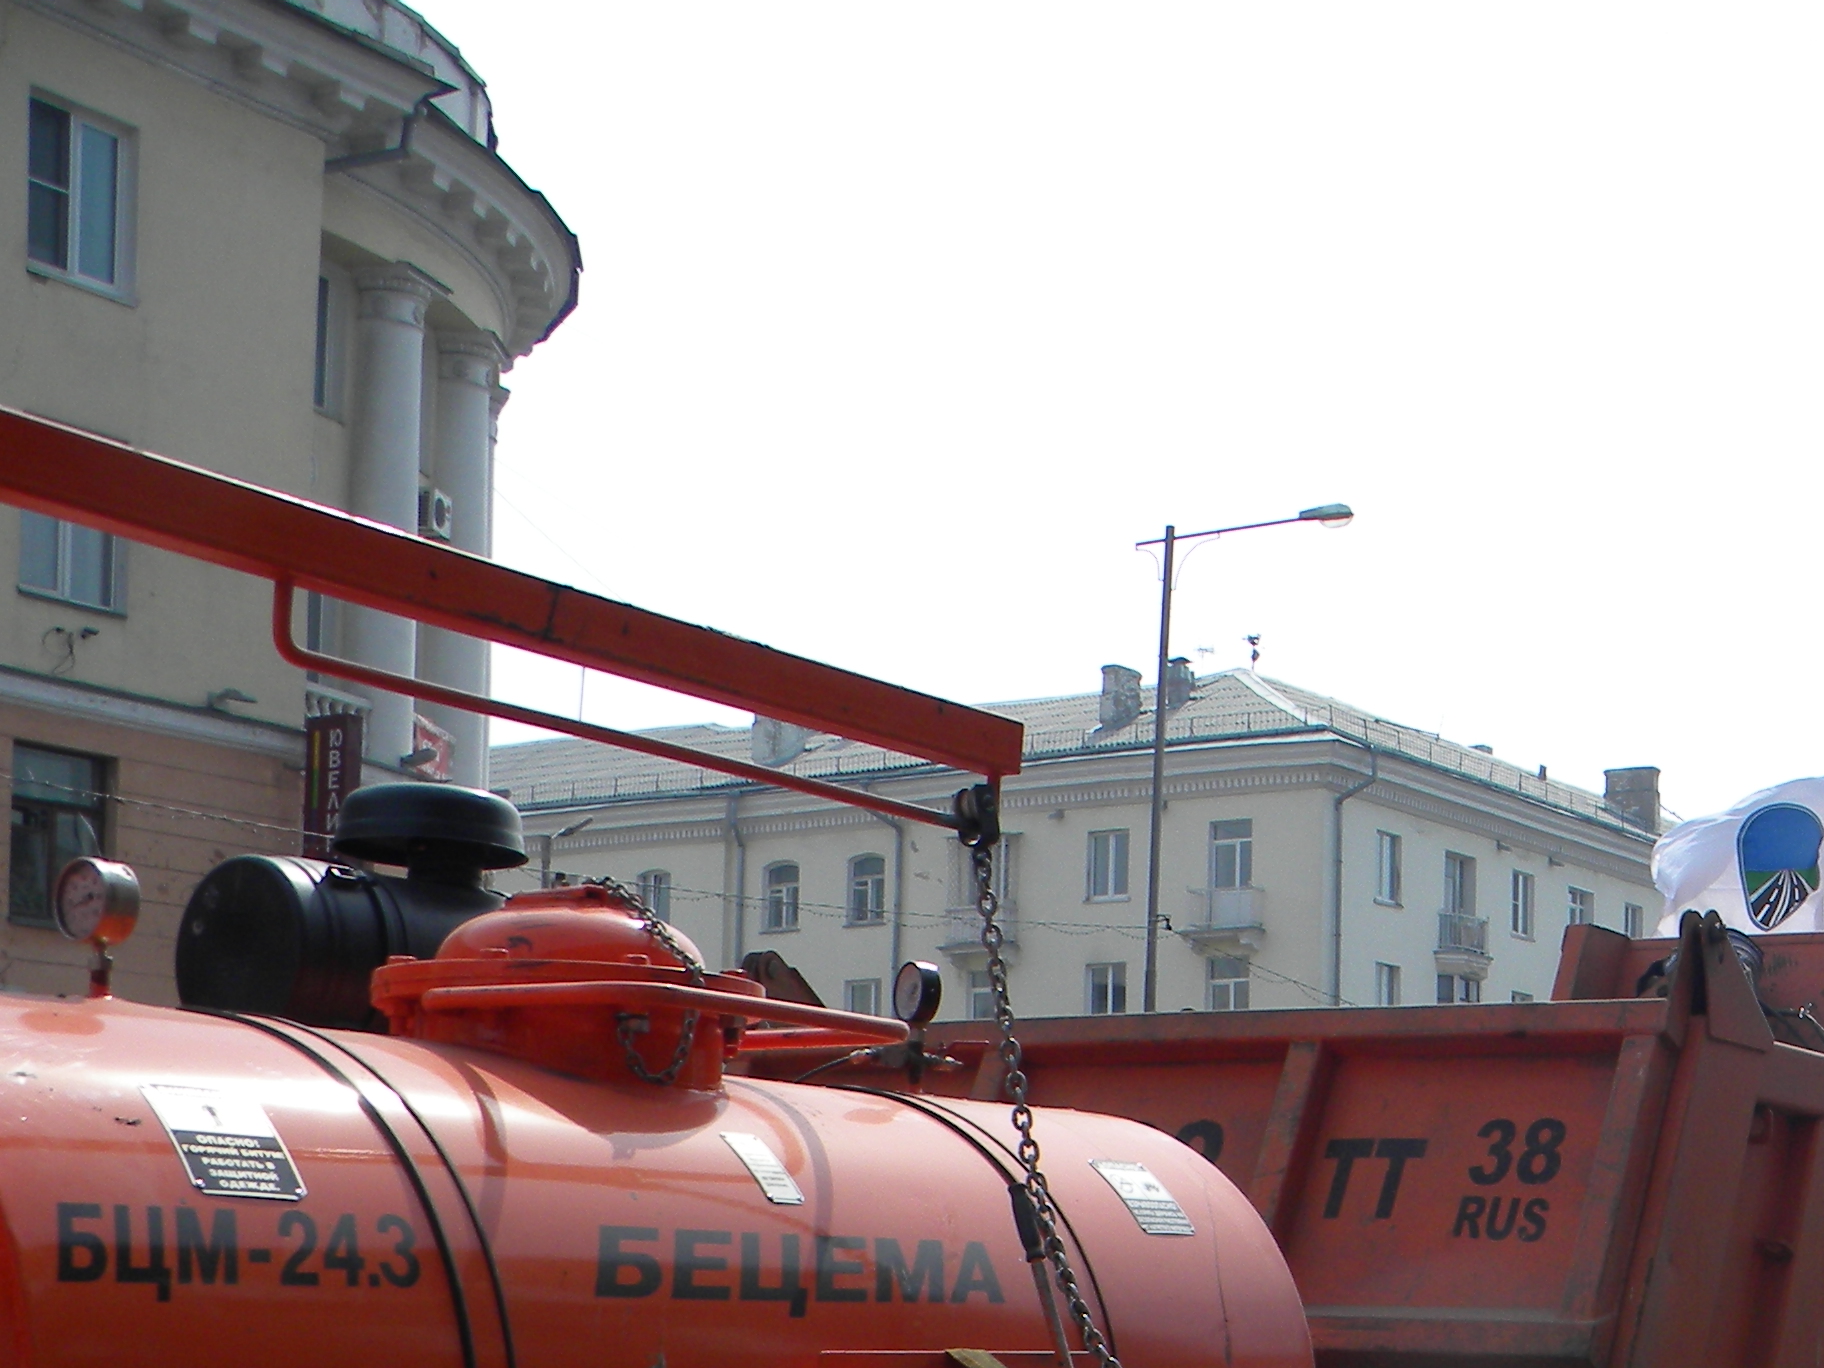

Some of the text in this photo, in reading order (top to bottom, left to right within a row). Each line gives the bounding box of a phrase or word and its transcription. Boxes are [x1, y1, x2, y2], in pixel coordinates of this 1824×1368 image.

[326, 728, 343, 853] ЮВЕЛИ
[195, 1133, 261, 1149] ОПАСНО!
[201, 1156, 265, 1170] РАБОТАТЬ
[1468, 1117, 1567, 1187] 38
[57, 1201, 421, 1302] БЦМ-24.3
[1452, 1194, 1551, 1243] RUS
[594, 1225, 1006, 1318] БЕЦЕМА
